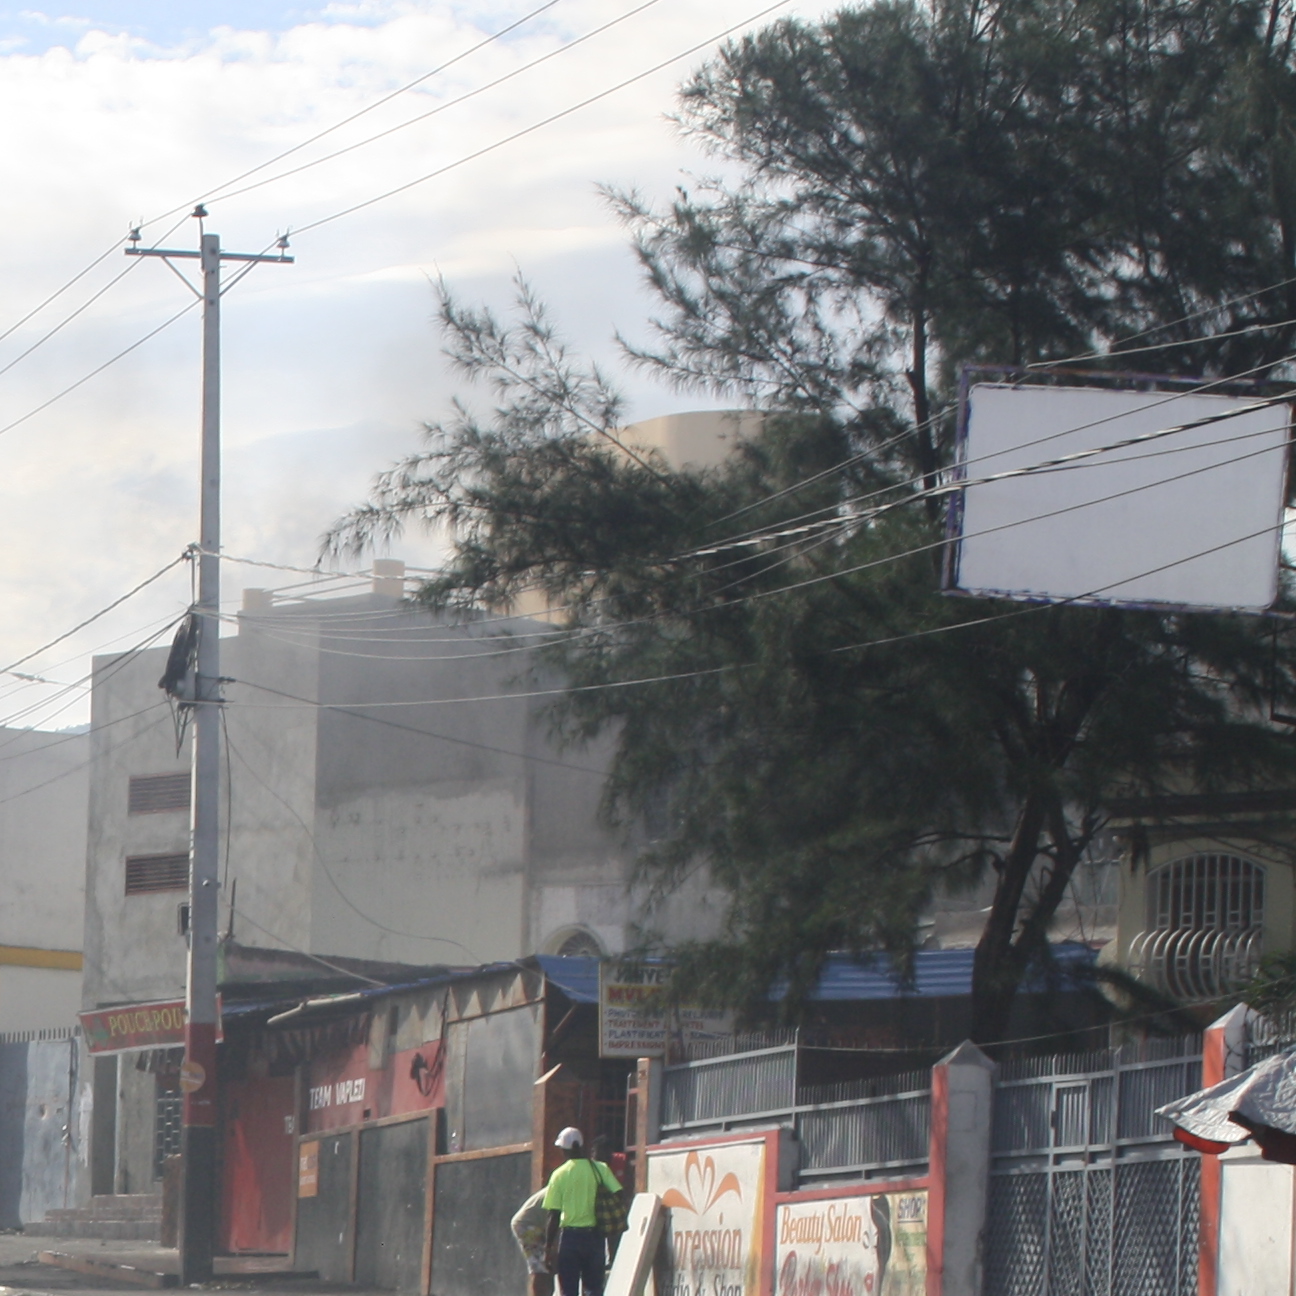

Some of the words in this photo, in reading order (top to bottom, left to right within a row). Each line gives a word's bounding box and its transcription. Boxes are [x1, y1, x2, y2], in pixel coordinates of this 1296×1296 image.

[310, 1085, 332, 1110] TEAM
[674, 1212, 742, 1270] pression
[780, 1206, 825, 1255] Beauty
[825, 1203, 862, 1243] Salon
